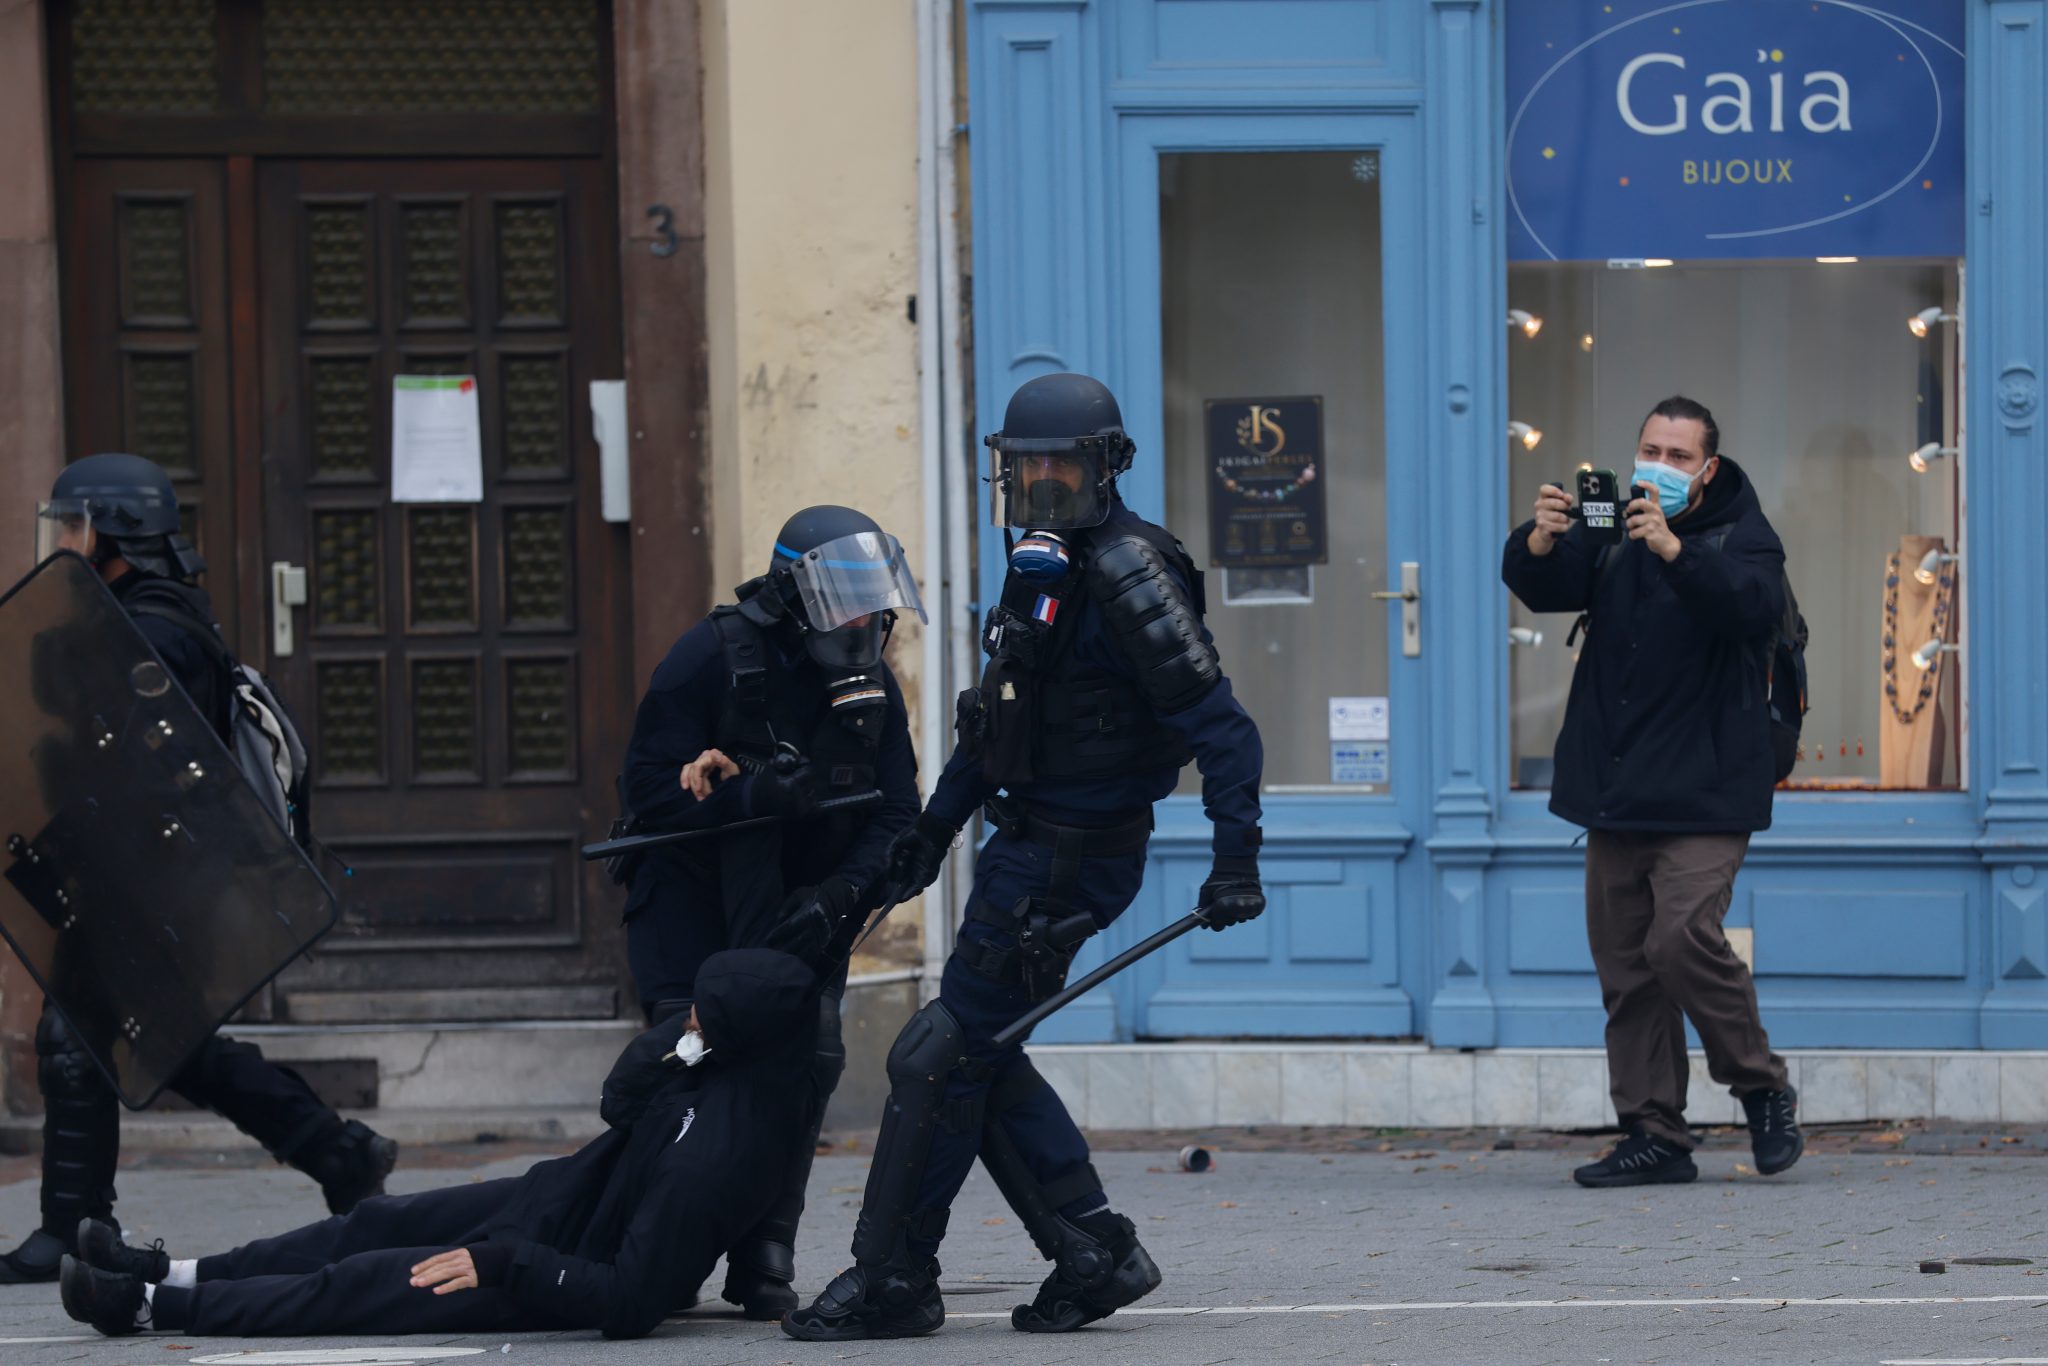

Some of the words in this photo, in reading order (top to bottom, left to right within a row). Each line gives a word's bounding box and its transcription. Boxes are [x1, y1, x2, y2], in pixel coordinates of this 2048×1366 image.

[1615, 49, 1853, 135] Gaïa
[1682, 159, 1794, 184] BIJOUX
[645, 203, 680, 257] 3
[1583, 504, 1615, 515] STRAS
